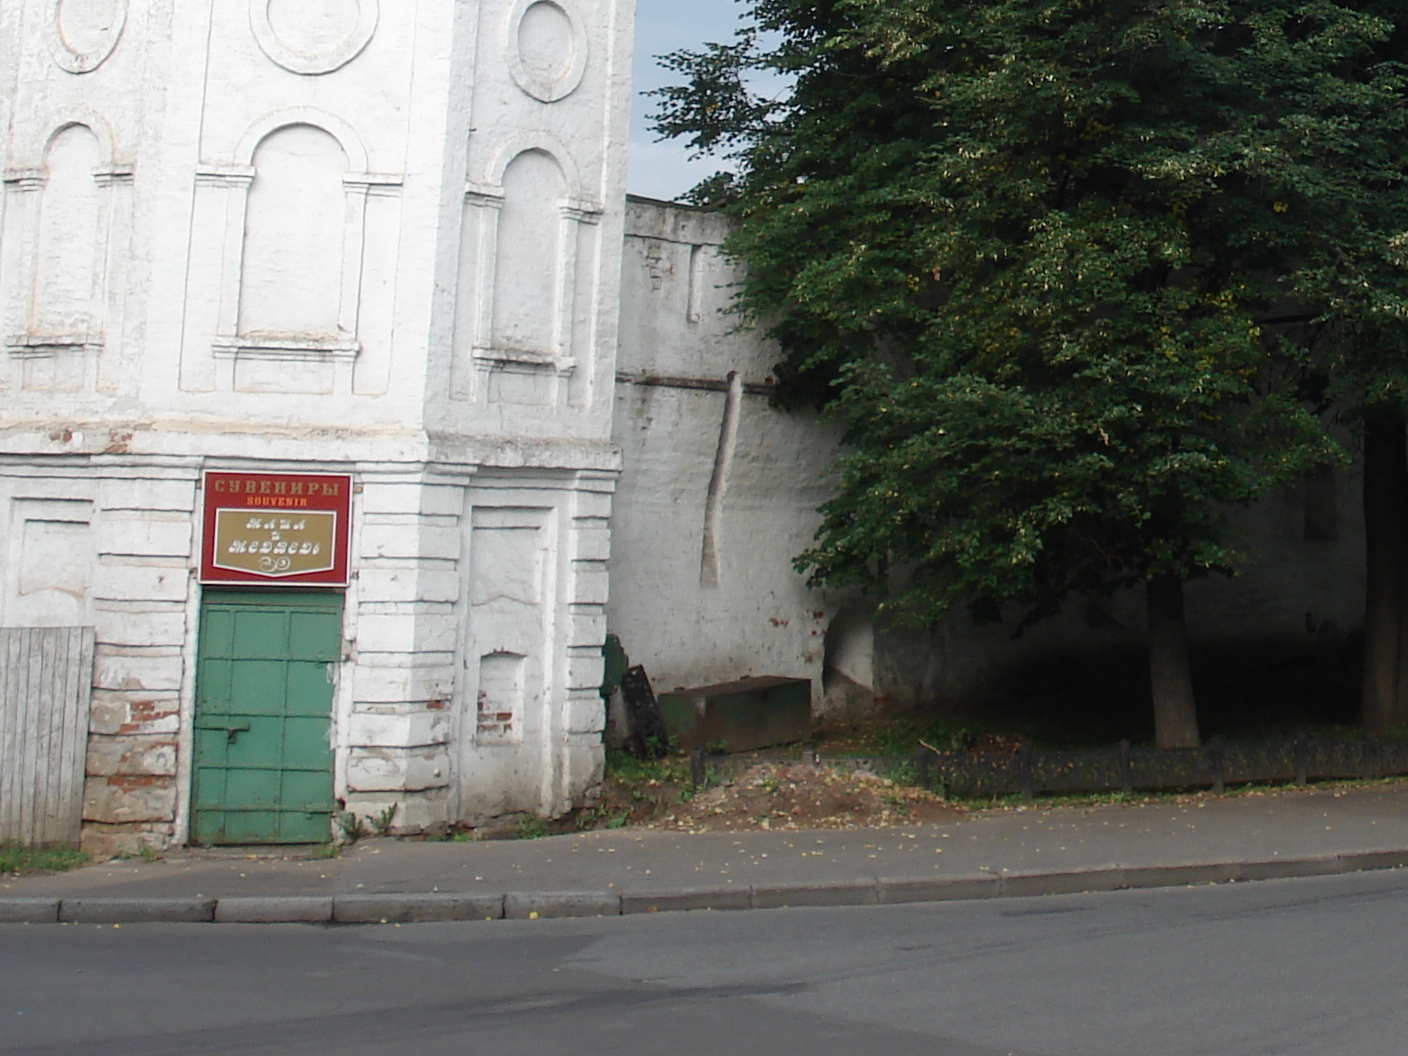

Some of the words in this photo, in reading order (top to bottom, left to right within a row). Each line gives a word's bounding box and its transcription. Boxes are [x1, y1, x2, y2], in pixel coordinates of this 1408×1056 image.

[215, 480, 339, 495] СУВЕНИРЫ
[247, 497, 307, 506] SOUVENIR
[246, 518, 305, 530] МАША
[228, 541, 320, 555] МЕДВЕДЬ
